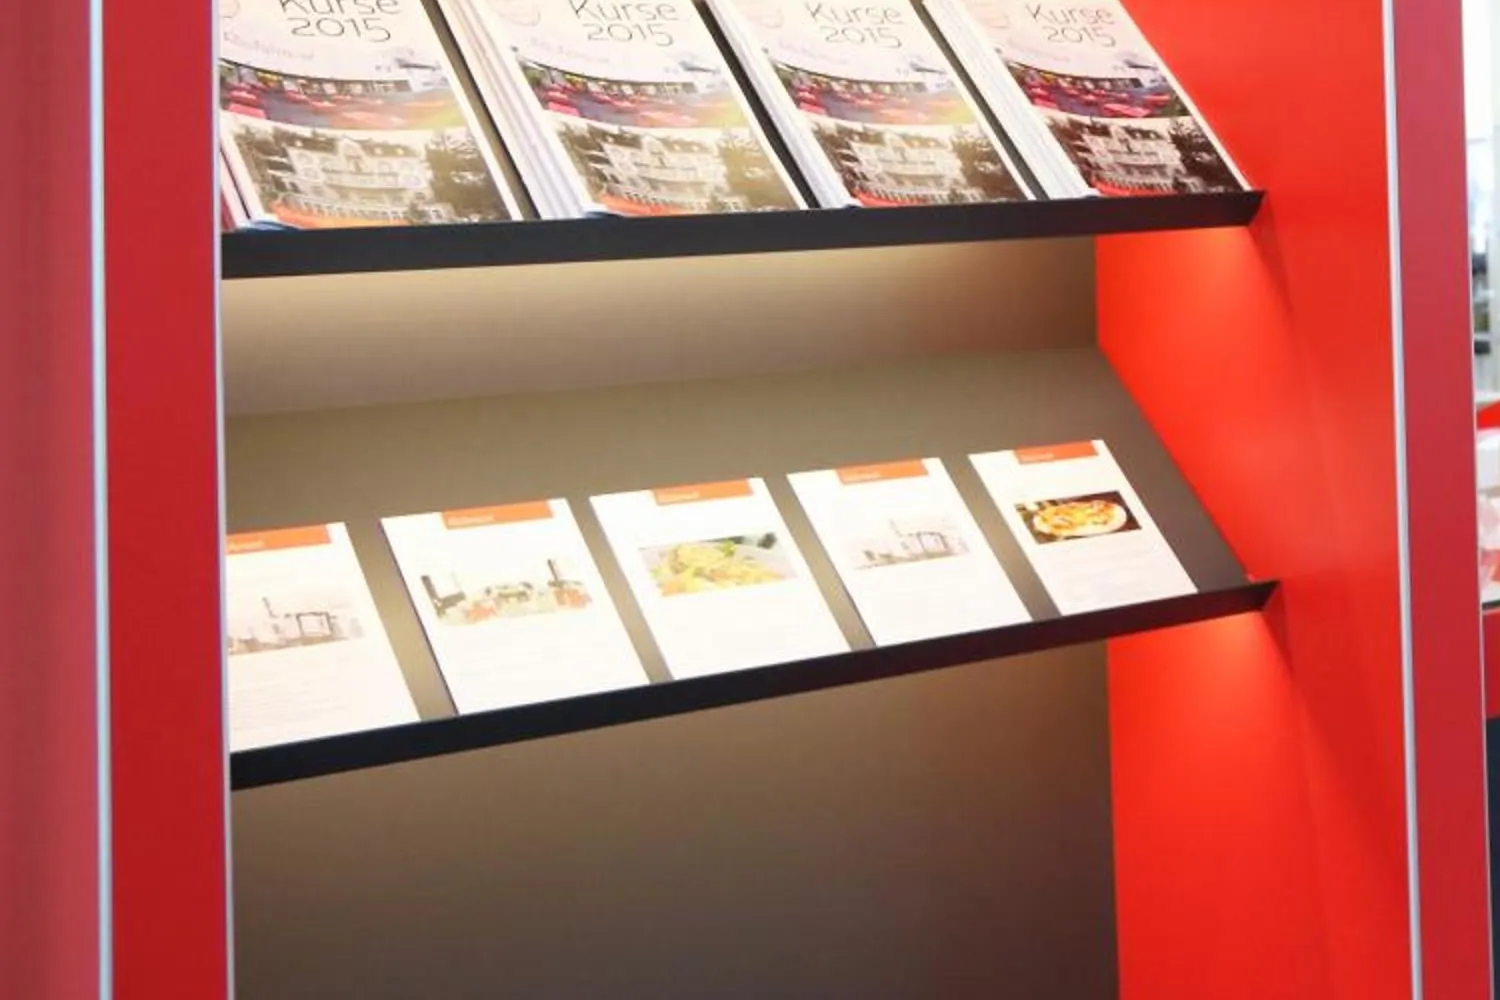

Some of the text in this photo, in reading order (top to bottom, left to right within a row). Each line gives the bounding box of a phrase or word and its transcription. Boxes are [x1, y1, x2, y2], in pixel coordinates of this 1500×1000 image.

[808, 3, 903, 25] Kurse
[1027, 4, 1114, 25] Kurse
[289, 17, 391, 43] 2015
[585, 23, 675, 48] 2015
[823, 26, 902, 48] 2015
[1045, 26, 1116, 48] 2015
